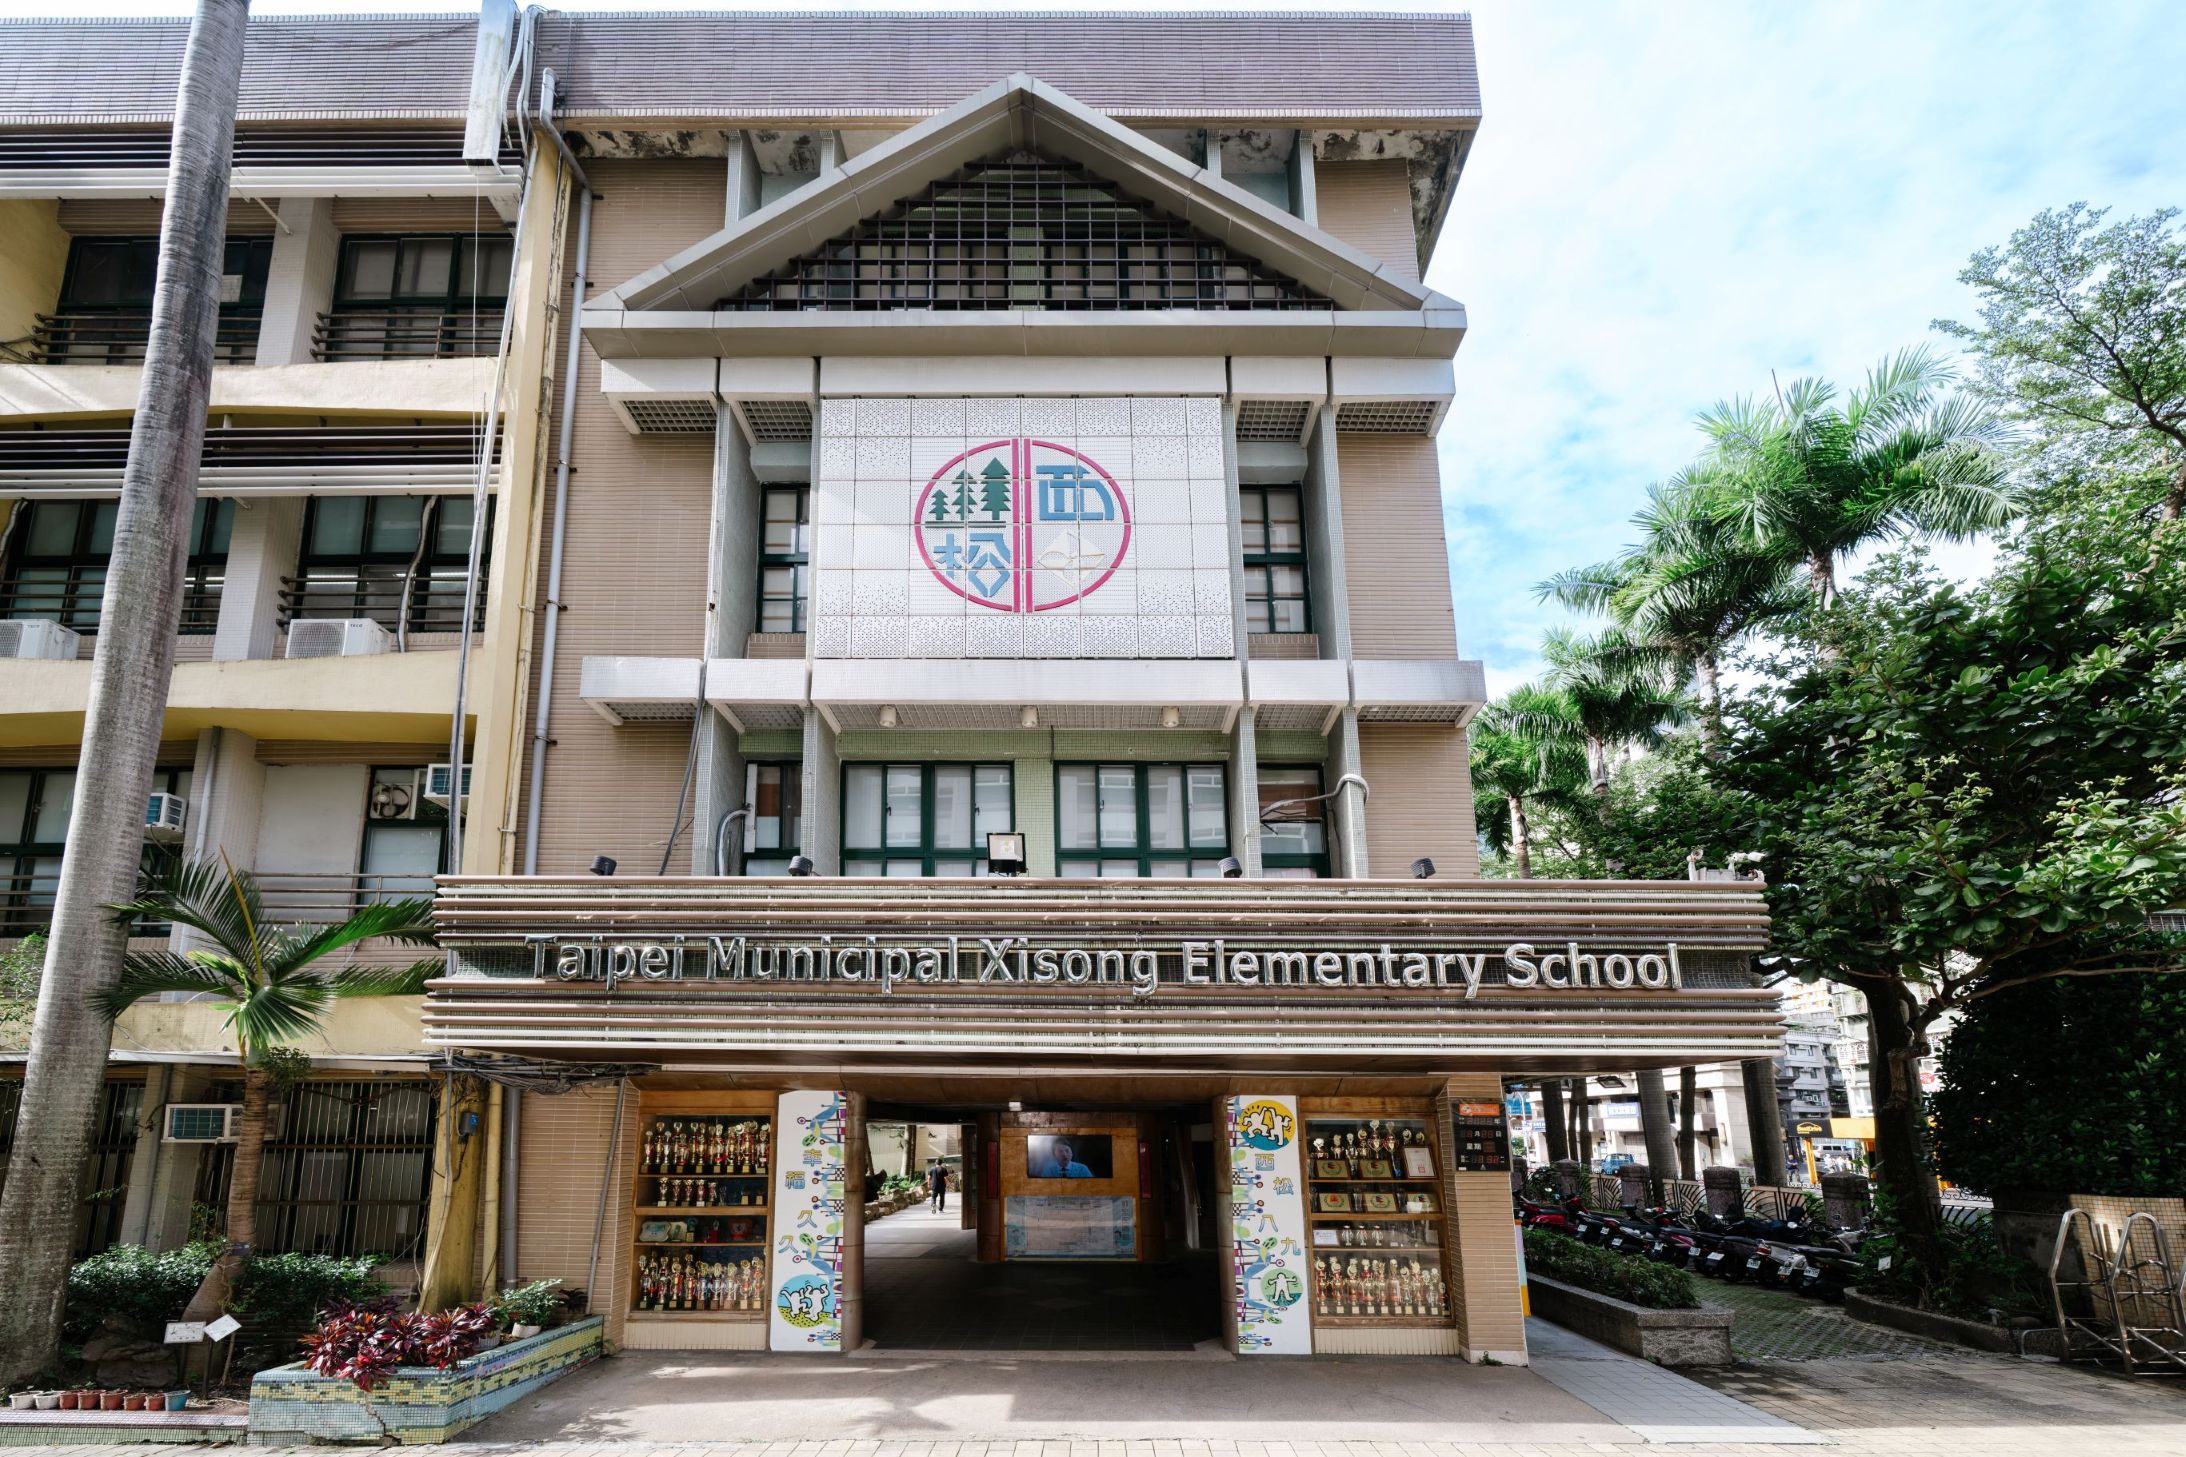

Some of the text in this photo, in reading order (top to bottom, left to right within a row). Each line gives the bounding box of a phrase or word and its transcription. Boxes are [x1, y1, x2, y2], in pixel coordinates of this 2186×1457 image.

[525, 935, 1684, 999] Taipei Municipal Xisong Elementary School
